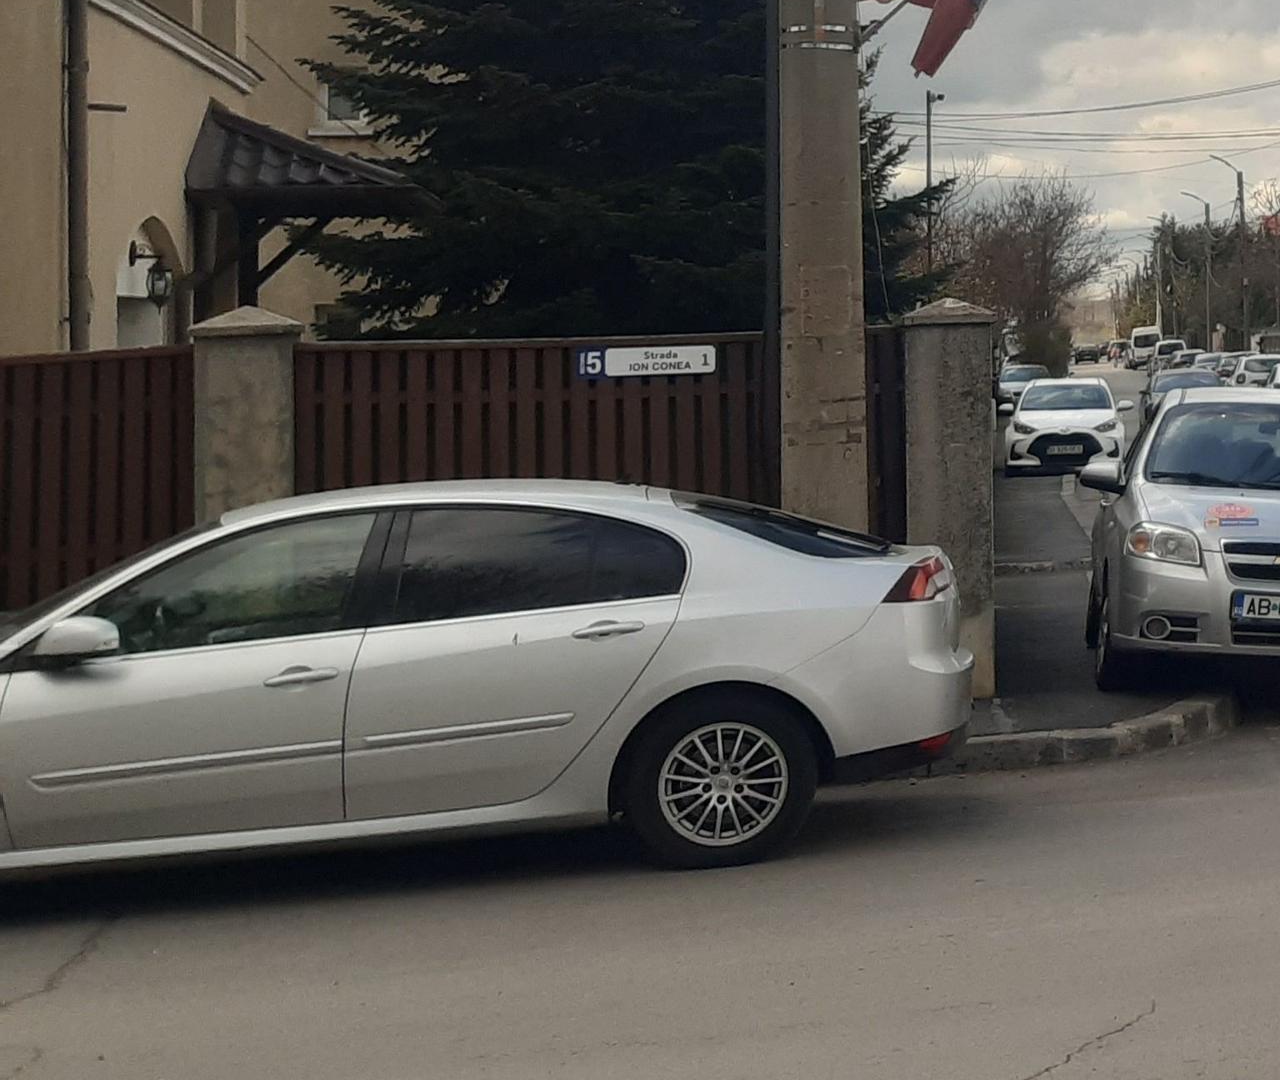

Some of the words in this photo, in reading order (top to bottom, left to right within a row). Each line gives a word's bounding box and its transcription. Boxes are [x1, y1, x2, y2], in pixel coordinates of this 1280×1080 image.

[643, 350, 678, 360] Strada
[701, 353, 710, 366] 1
[628, 362, 649, 372] ION
[652, 361, 692, 371] CONEA
[1246, 597, 1271, 616] AB
